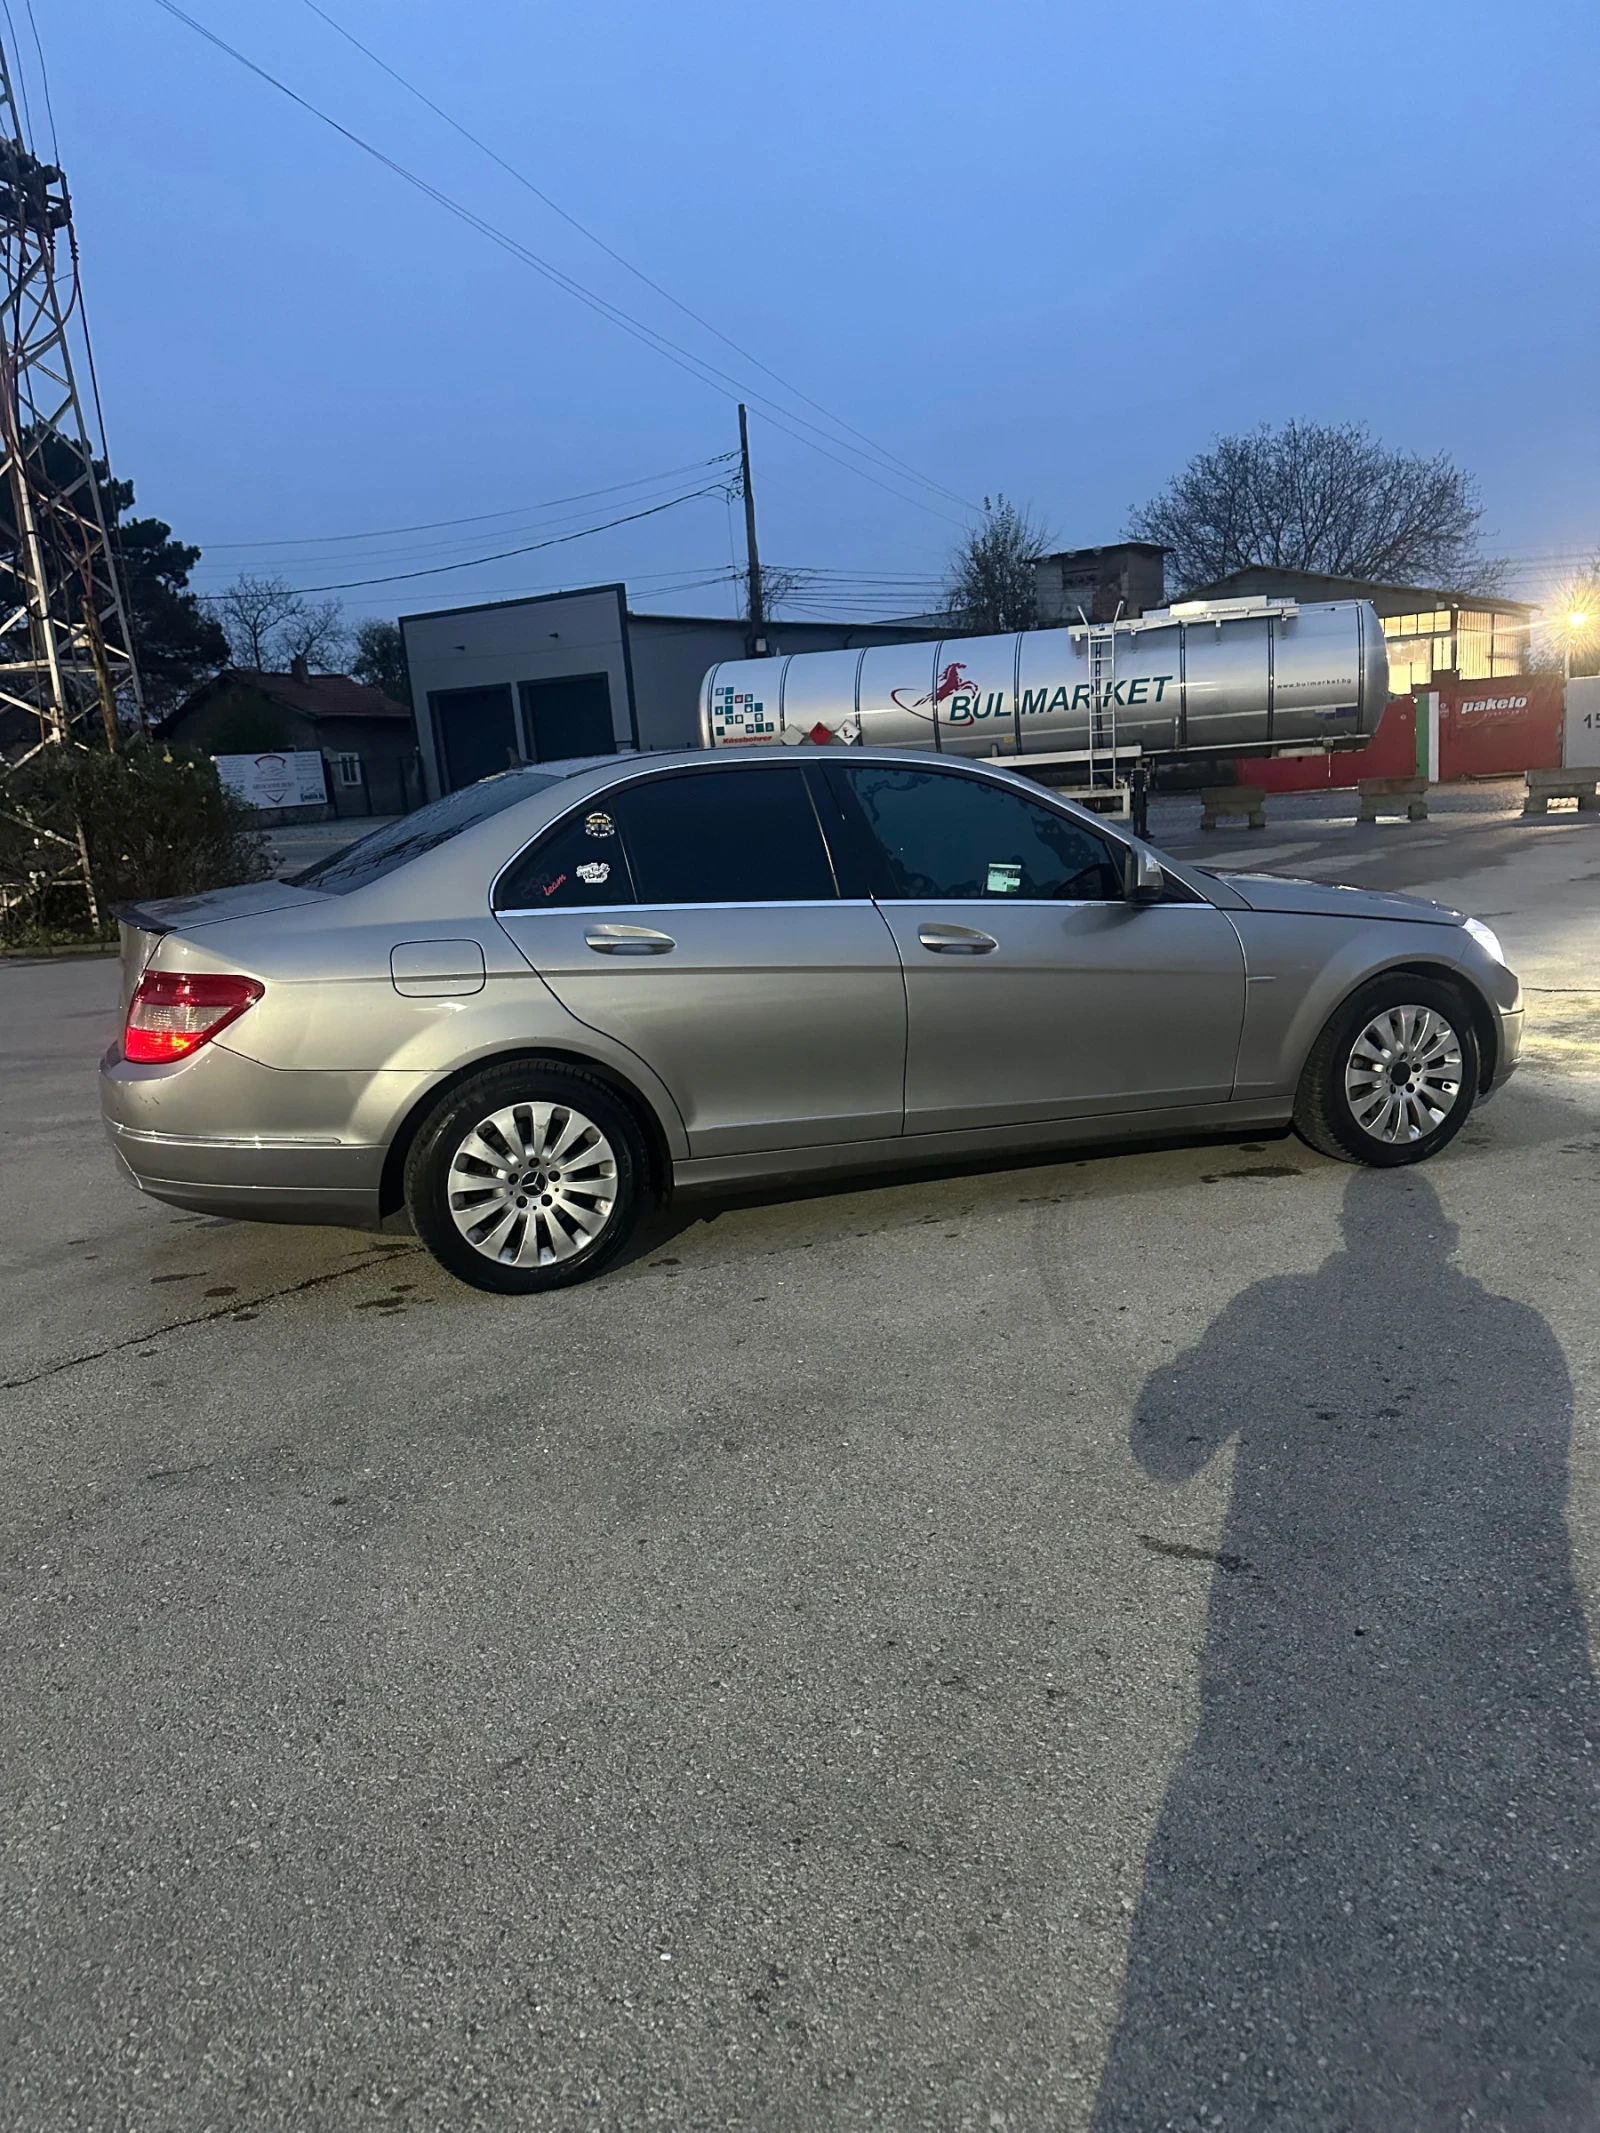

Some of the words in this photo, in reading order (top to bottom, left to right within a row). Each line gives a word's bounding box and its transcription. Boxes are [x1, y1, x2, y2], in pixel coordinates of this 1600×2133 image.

[1276, 678, 1352, 689] www.bulmarket.bg
[1461, 696, 1528, 715] pakelo
[542, 874, 566, 896] team
